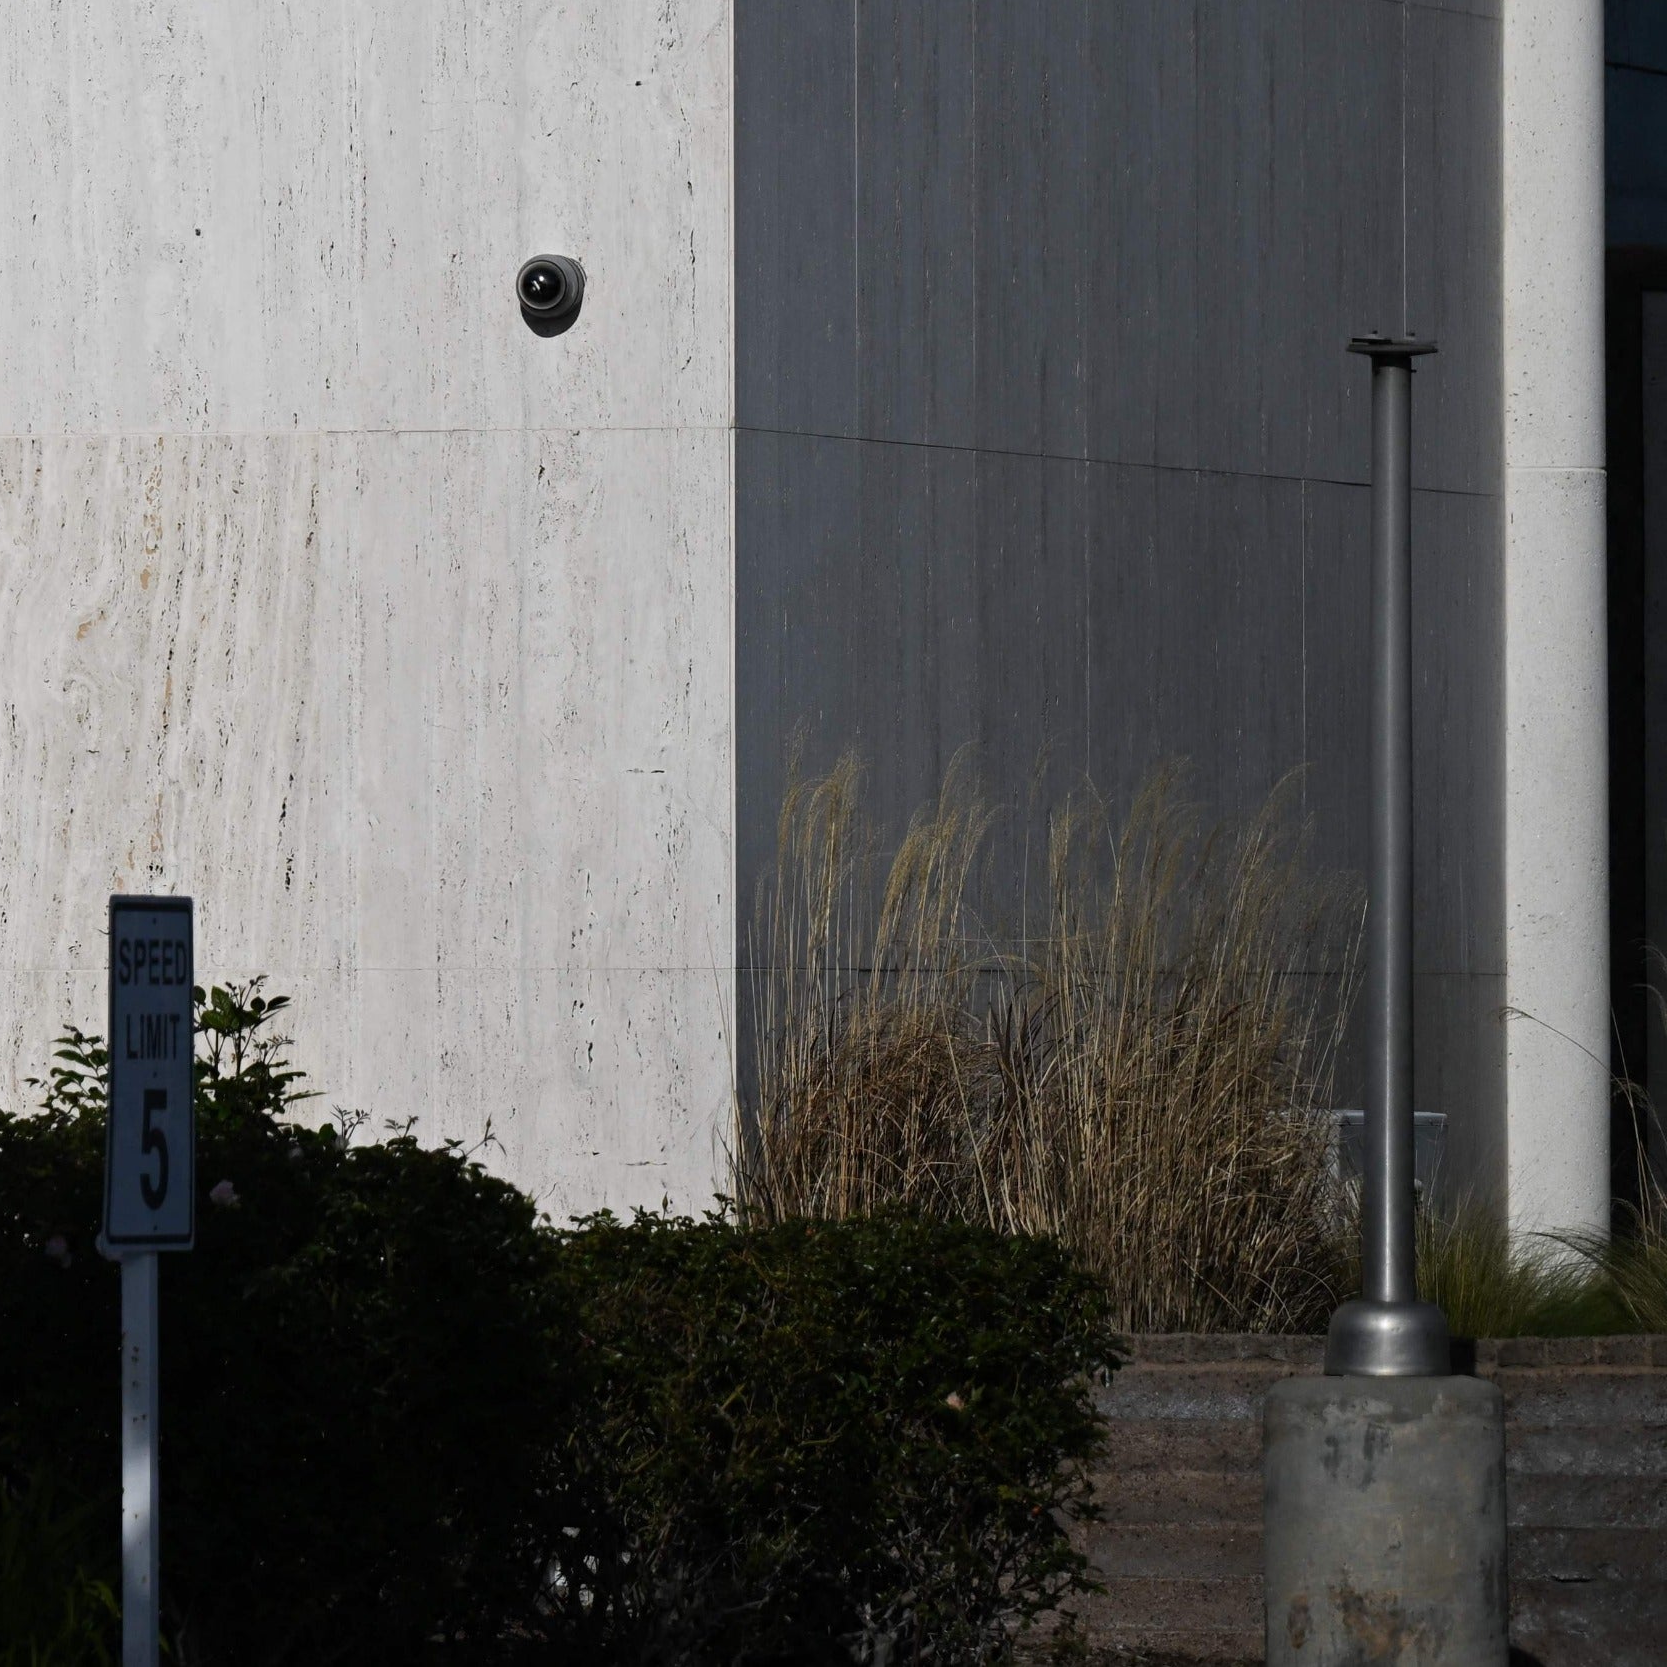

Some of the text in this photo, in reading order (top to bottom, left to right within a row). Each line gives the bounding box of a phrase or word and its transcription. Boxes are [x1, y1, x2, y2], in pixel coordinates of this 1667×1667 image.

[118, 937, 187, 985] SPEED
[125, 1013, 180, 1061] LIMIT
[139, 1089, 169, 1211] 5
